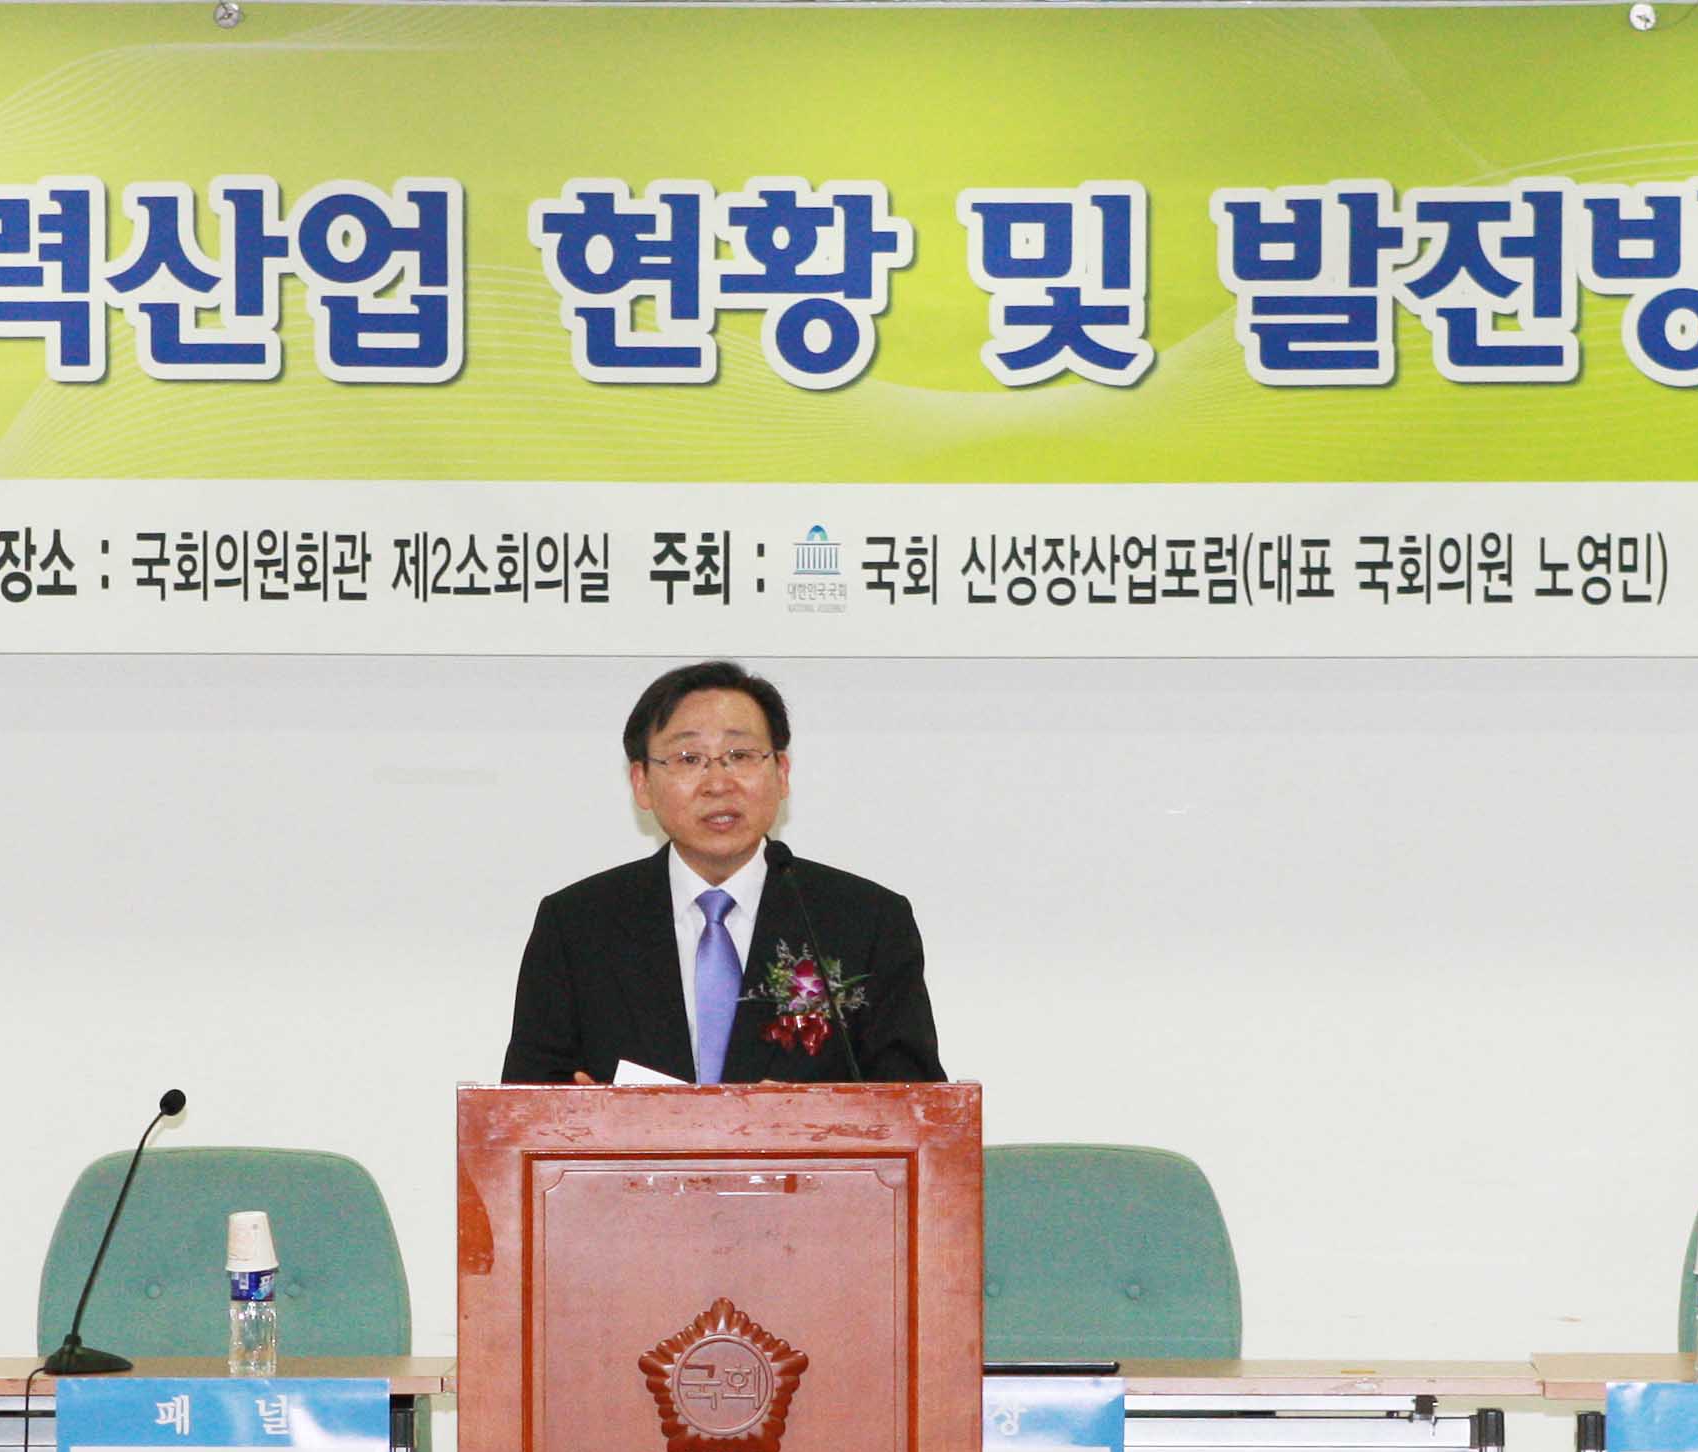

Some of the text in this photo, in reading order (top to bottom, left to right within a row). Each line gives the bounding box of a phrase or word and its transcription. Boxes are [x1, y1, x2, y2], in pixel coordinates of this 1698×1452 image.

[535, 182, 909, 384] 현황
[965, 184, 1145, 380] 및
[131, 529, 373, 602] 국회의원회관
[390, 530, 611, 604] 제2소회의실
[648, 530, 731, 605] 주최
[861, 534, 939, 606] 국회
[960, 532, 1336, 606] 신성장산업포럼(대표
[1354, 532, 1514, 606] 국회의원
[1534, 532, 1669, 607] 노영민)
[680, 1363, 761, 1411] 국회
